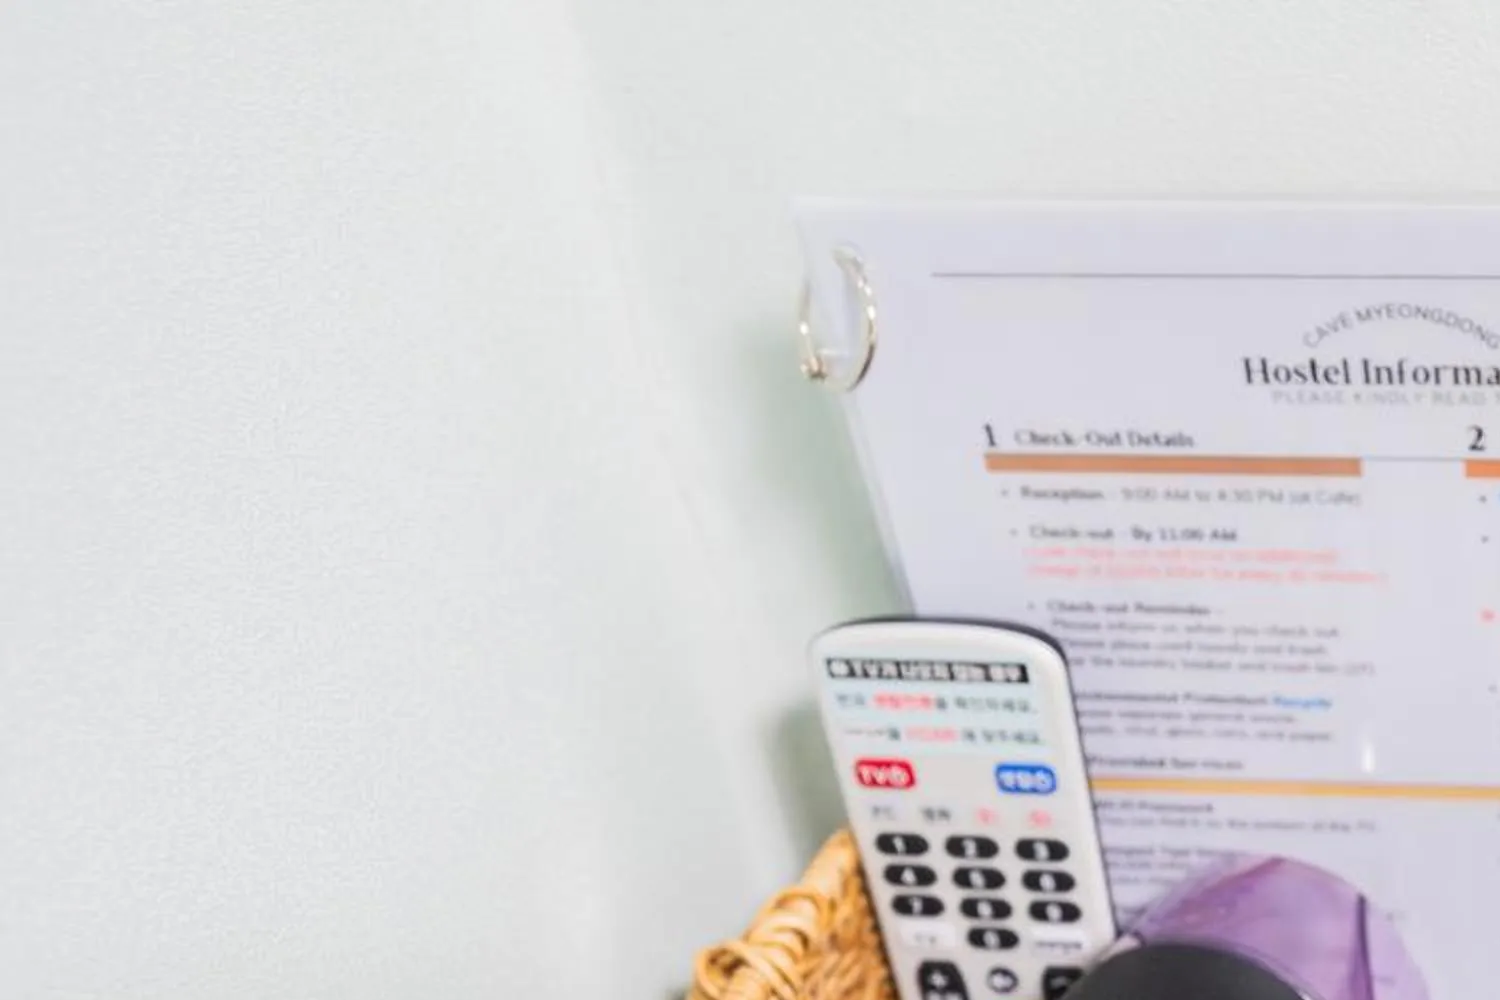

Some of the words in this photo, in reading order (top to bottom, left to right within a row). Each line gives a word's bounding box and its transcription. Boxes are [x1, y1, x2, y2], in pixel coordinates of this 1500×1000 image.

[1303, 313, 1350, 348] CAVE
[1243, 357, 1351, 386] Hostel
[1272, 391, 1347, 405] PLEASE
[983, 424, 997, 446] 1
[1014, 431, 1122, 447] Check-Out
[1129, 432, 1194, 448] Details
[1468, 426, 1487, 451] 2
